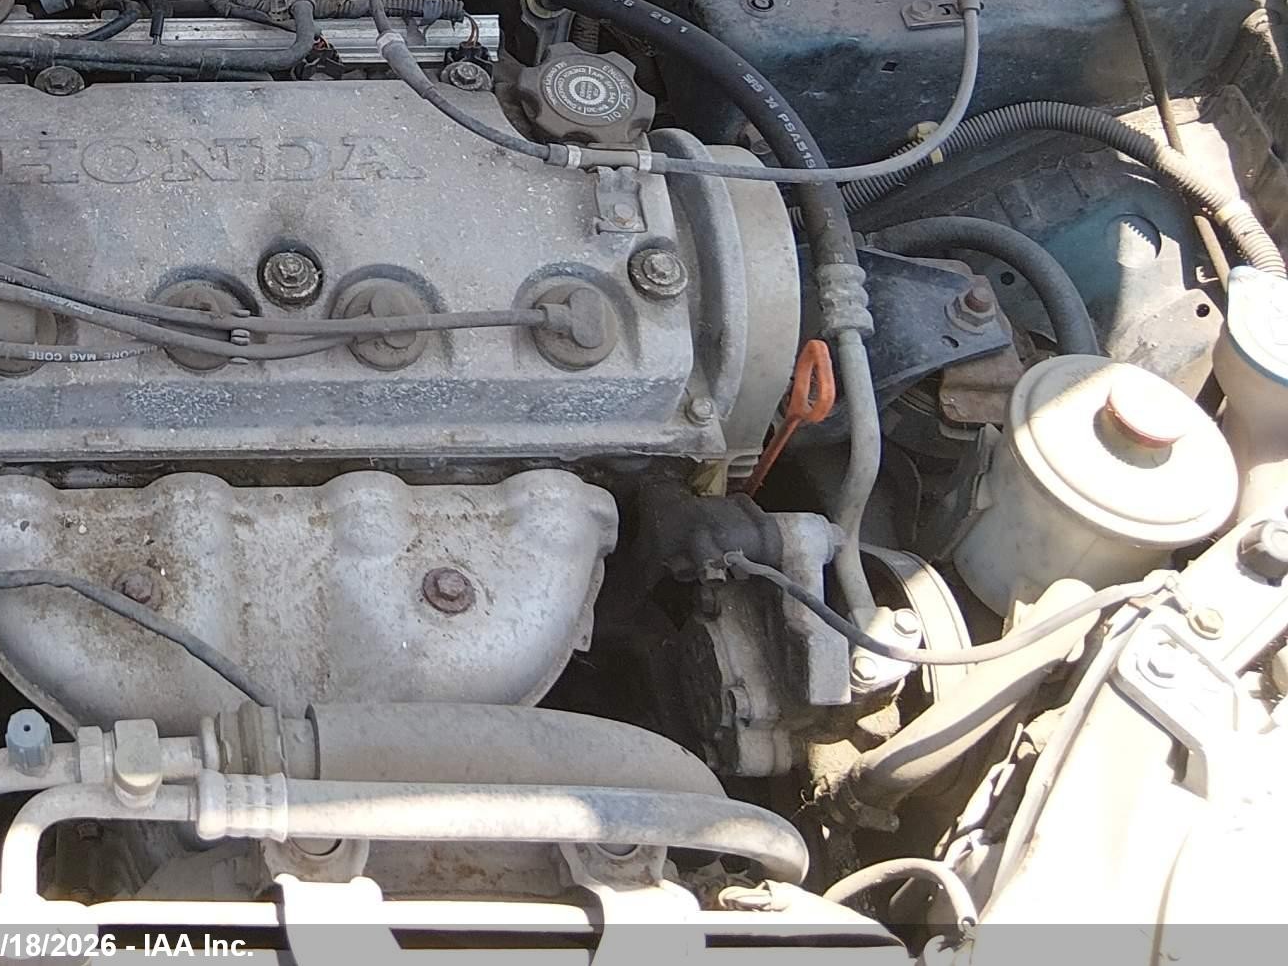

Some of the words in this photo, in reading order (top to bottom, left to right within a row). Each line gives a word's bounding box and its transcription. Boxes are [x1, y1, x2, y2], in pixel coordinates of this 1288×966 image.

[602, 111, 622, 122] OIL
[27, 349, 63, 361] CORE
[69, 351, 97, 362] MAG
